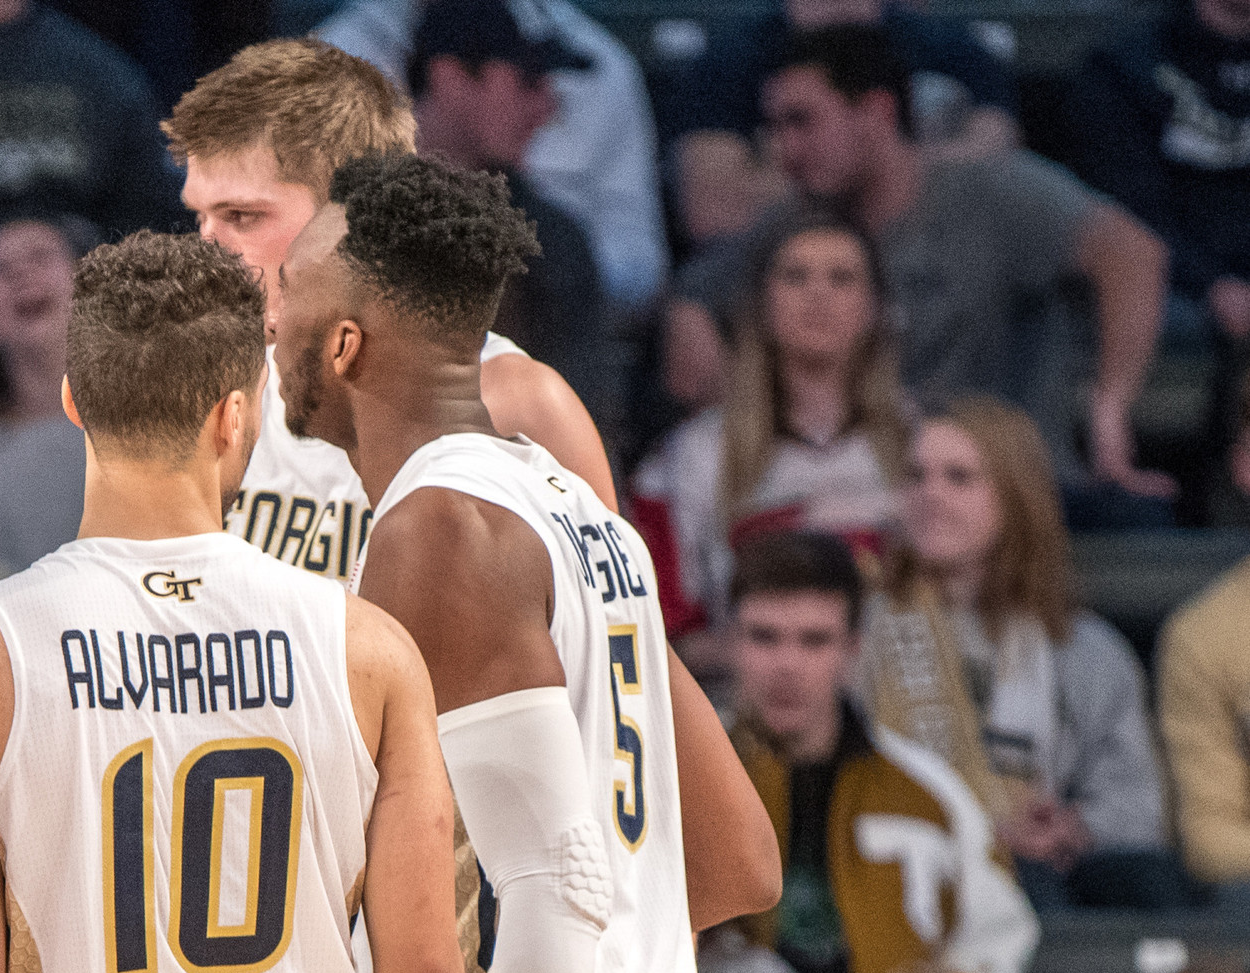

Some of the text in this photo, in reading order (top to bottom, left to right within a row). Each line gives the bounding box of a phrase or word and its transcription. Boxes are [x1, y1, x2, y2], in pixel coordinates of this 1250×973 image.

[222, 489, 374, 580] ORGI
[141, 570, 202, 603] GT
[61, 628, 295, 714] ALVARADO
[606, 624, 648, 855] 5
